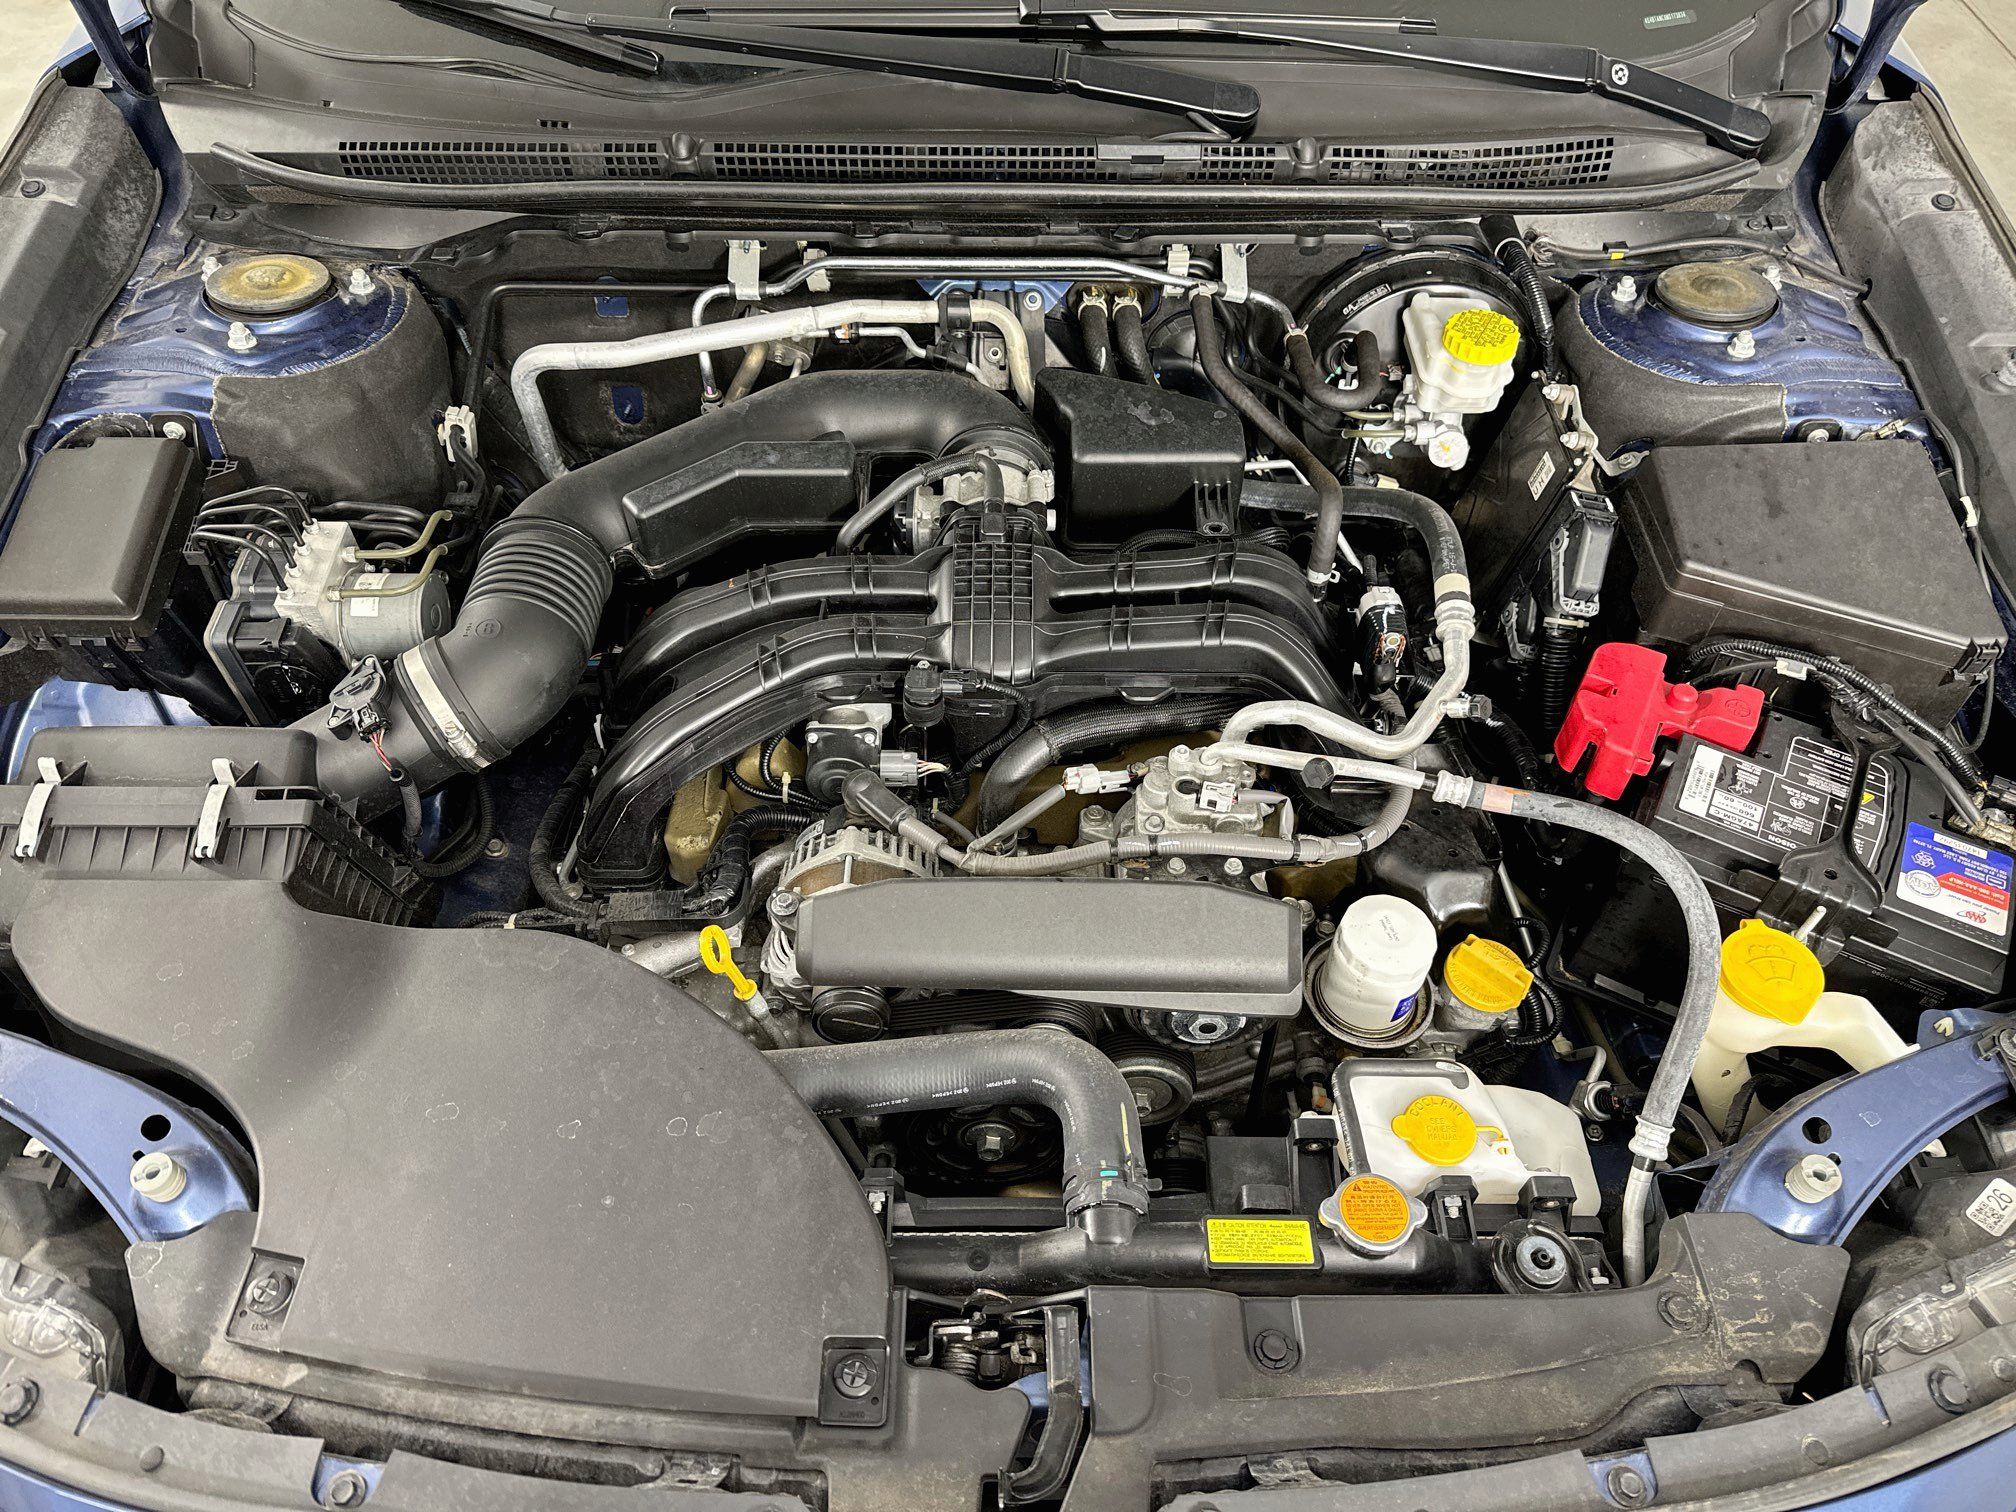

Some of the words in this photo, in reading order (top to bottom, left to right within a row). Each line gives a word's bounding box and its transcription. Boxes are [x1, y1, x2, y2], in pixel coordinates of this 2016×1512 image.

[1713, 809, 1753, 827] 47AGM-C
[1767, 834, 1797, 848] OISON
[1906, 874, 1937, 893] AGM
[1965, 909, 1985, 924] AAA
[1409, 1098, 1465, 1117] COOLANT
[1986, 1188, 2013, 1211] 26
